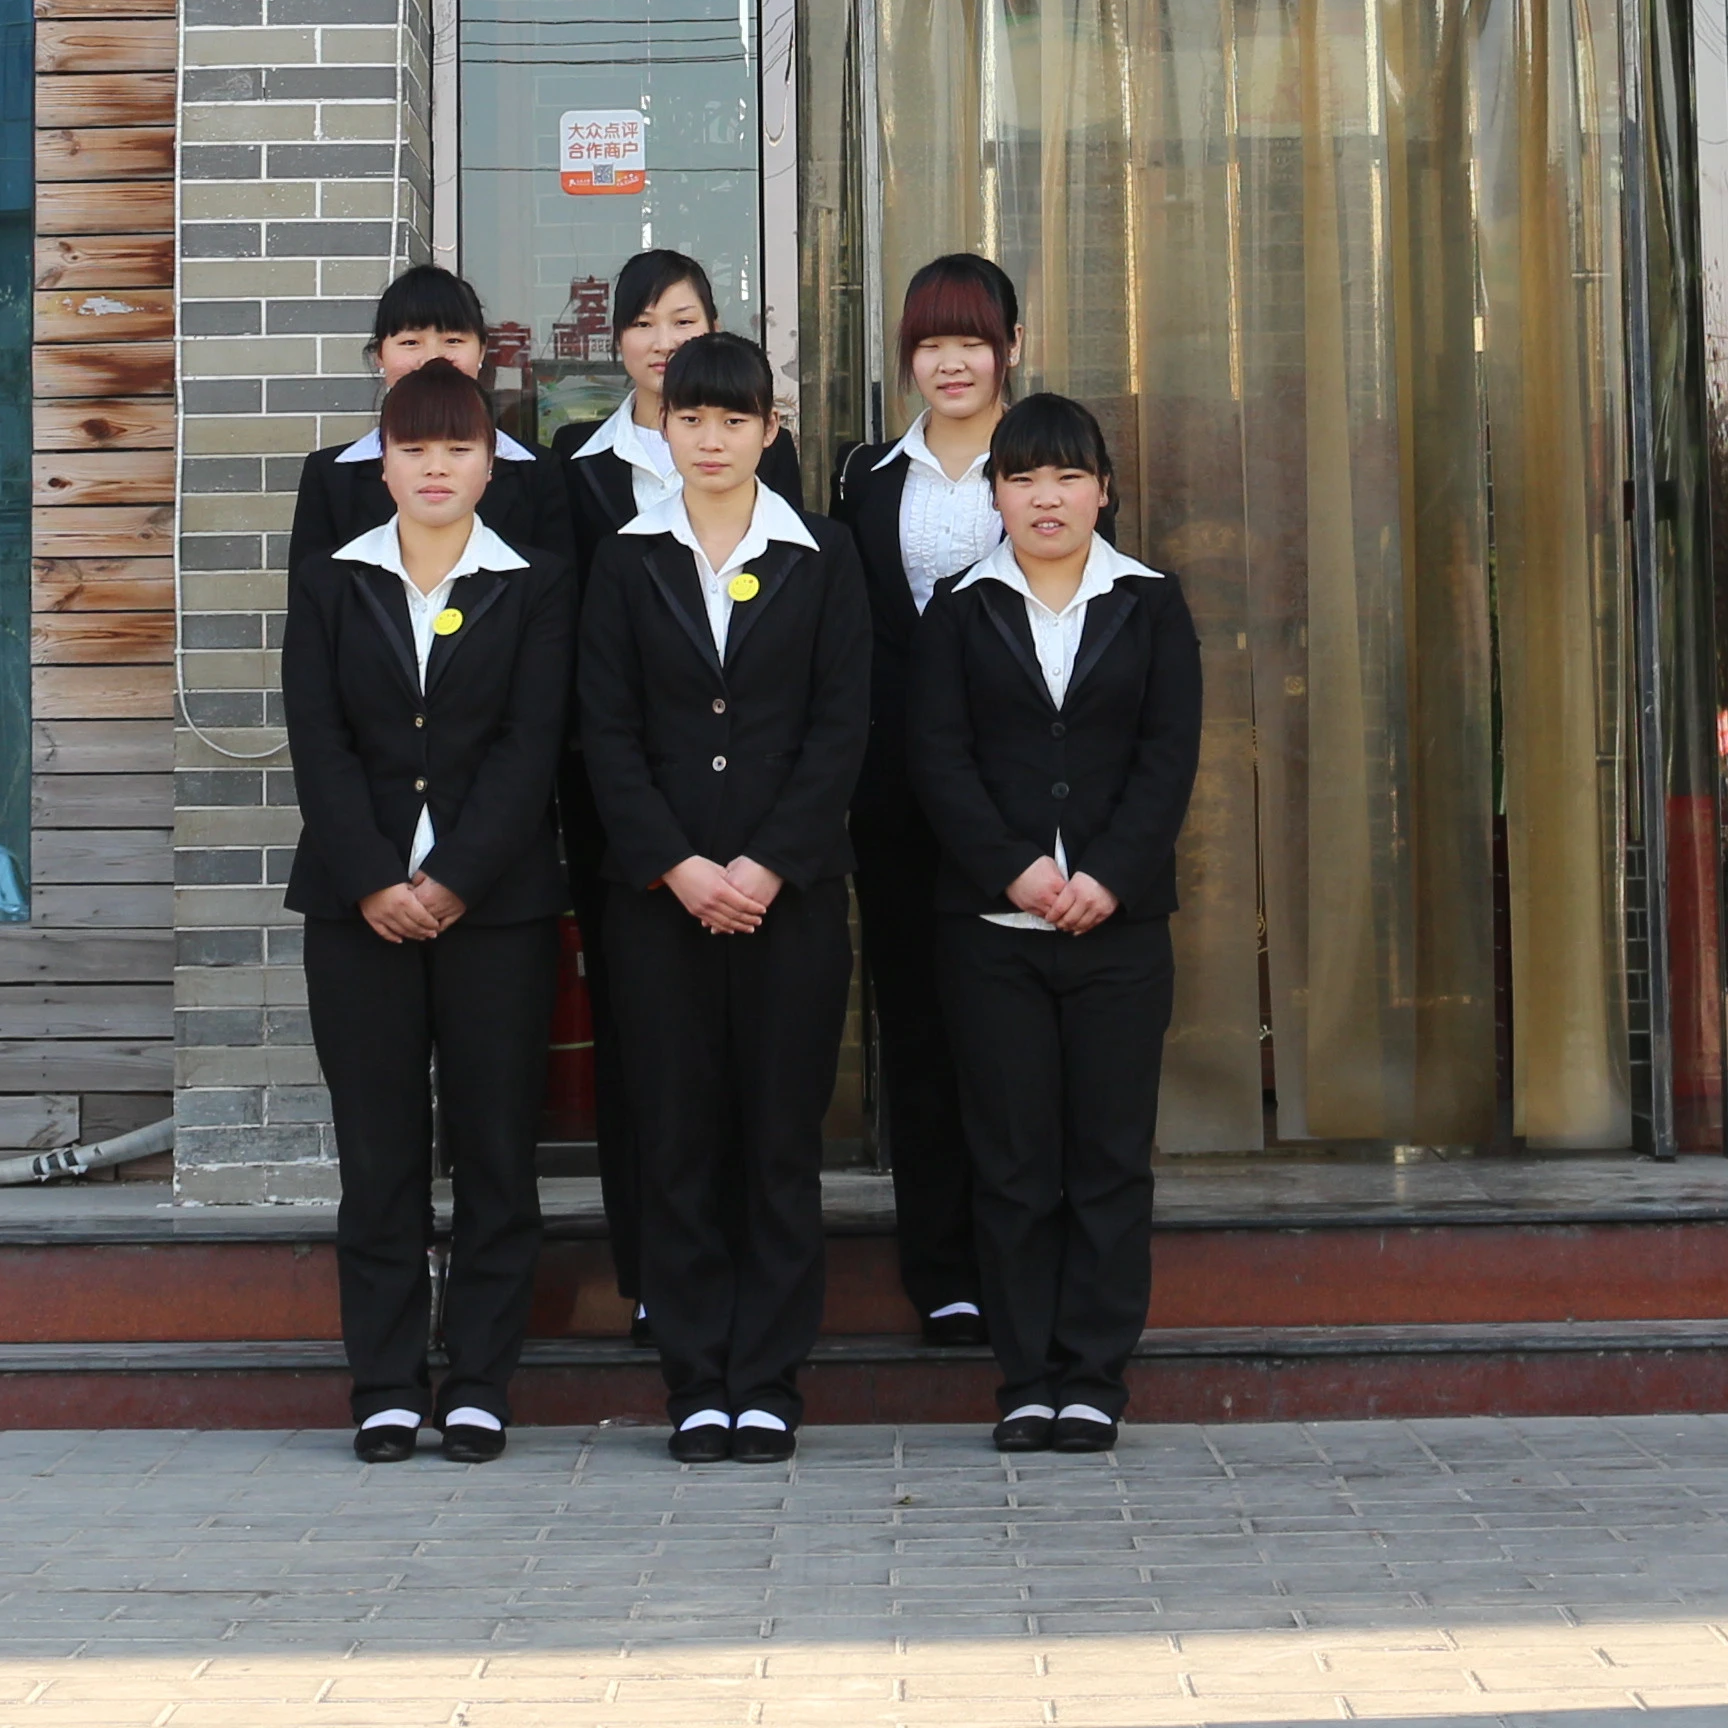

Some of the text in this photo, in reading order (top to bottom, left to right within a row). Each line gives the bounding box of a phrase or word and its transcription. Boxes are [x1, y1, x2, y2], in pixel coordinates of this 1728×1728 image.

[568, 122, 639, 140] 大众点评
[568, 142, 639, 159] 合作商户
